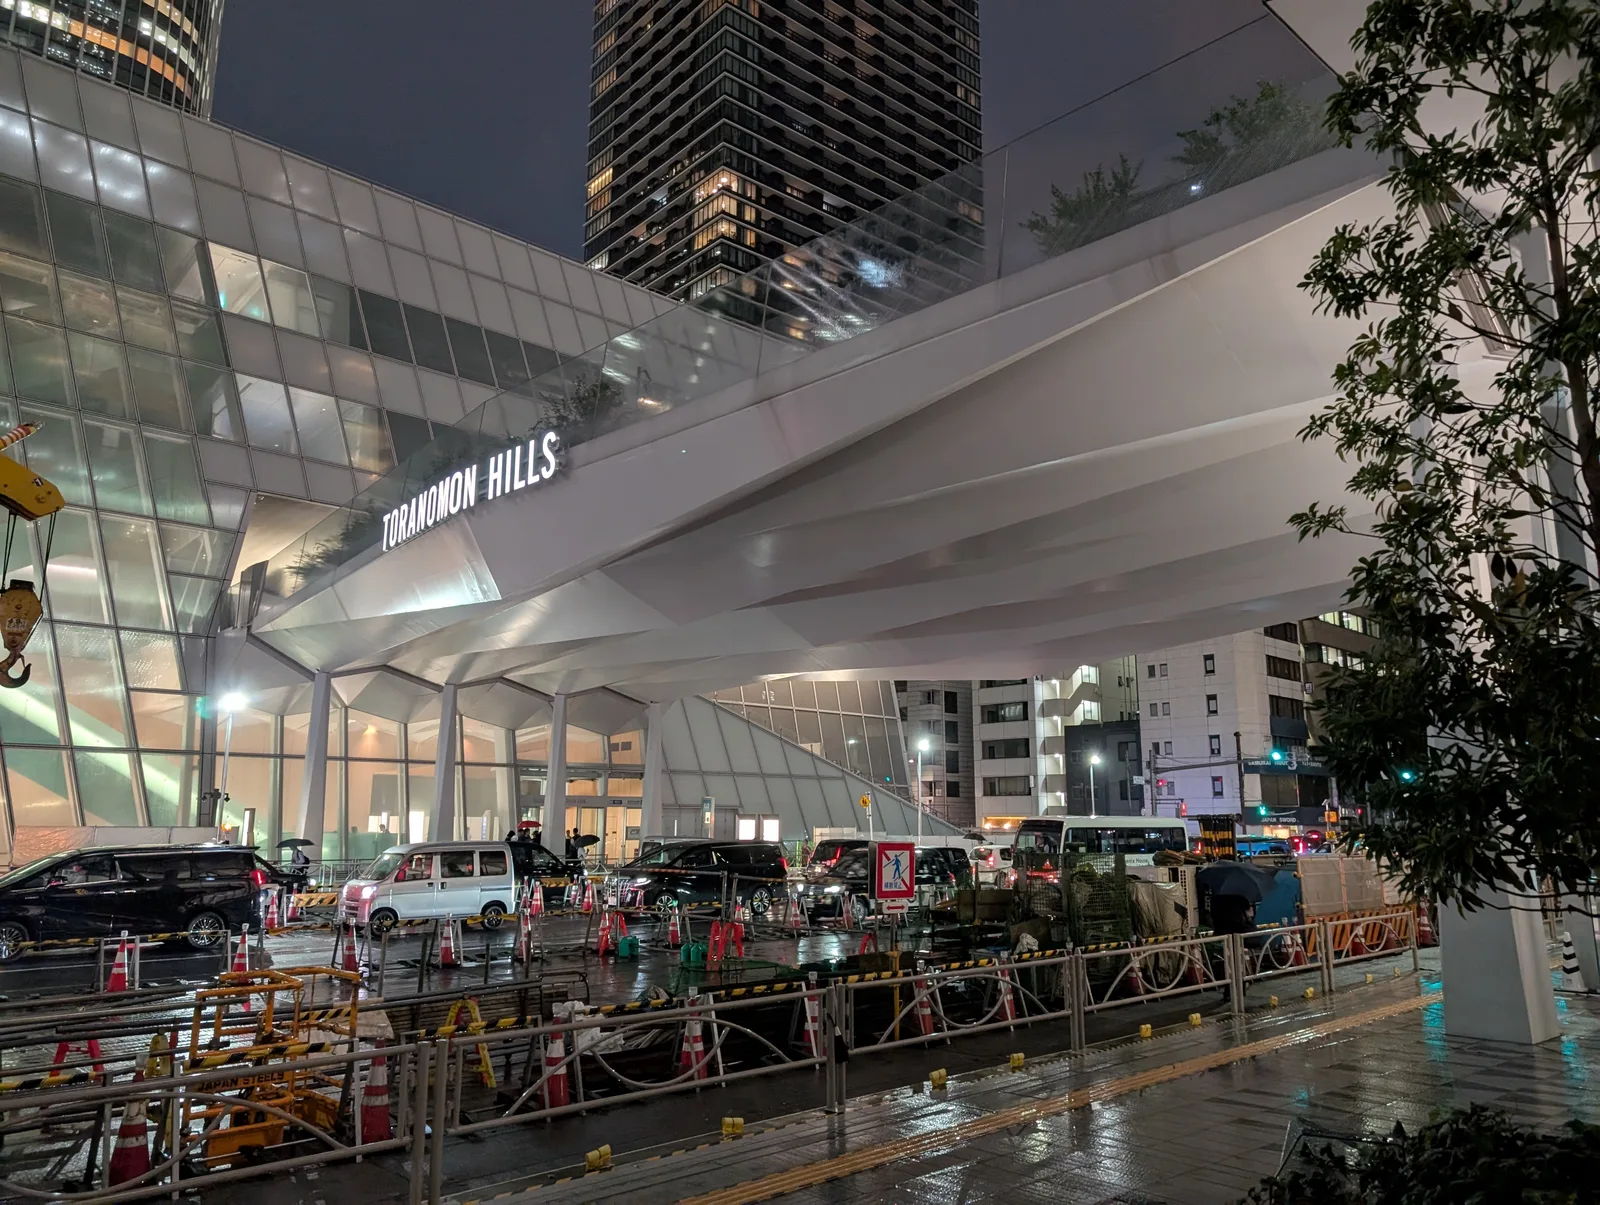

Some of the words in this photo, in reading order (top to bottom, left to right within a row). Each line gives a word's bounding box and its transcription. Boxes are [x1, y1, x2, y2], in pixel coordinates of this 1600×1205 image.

[382, 464, 477, 551] TORANOMON
[487, 431, 560, 500] HILLS
[198, 1076, 239, 1091] JAPAN
[243, 1072, 285, 1085] STEELS
